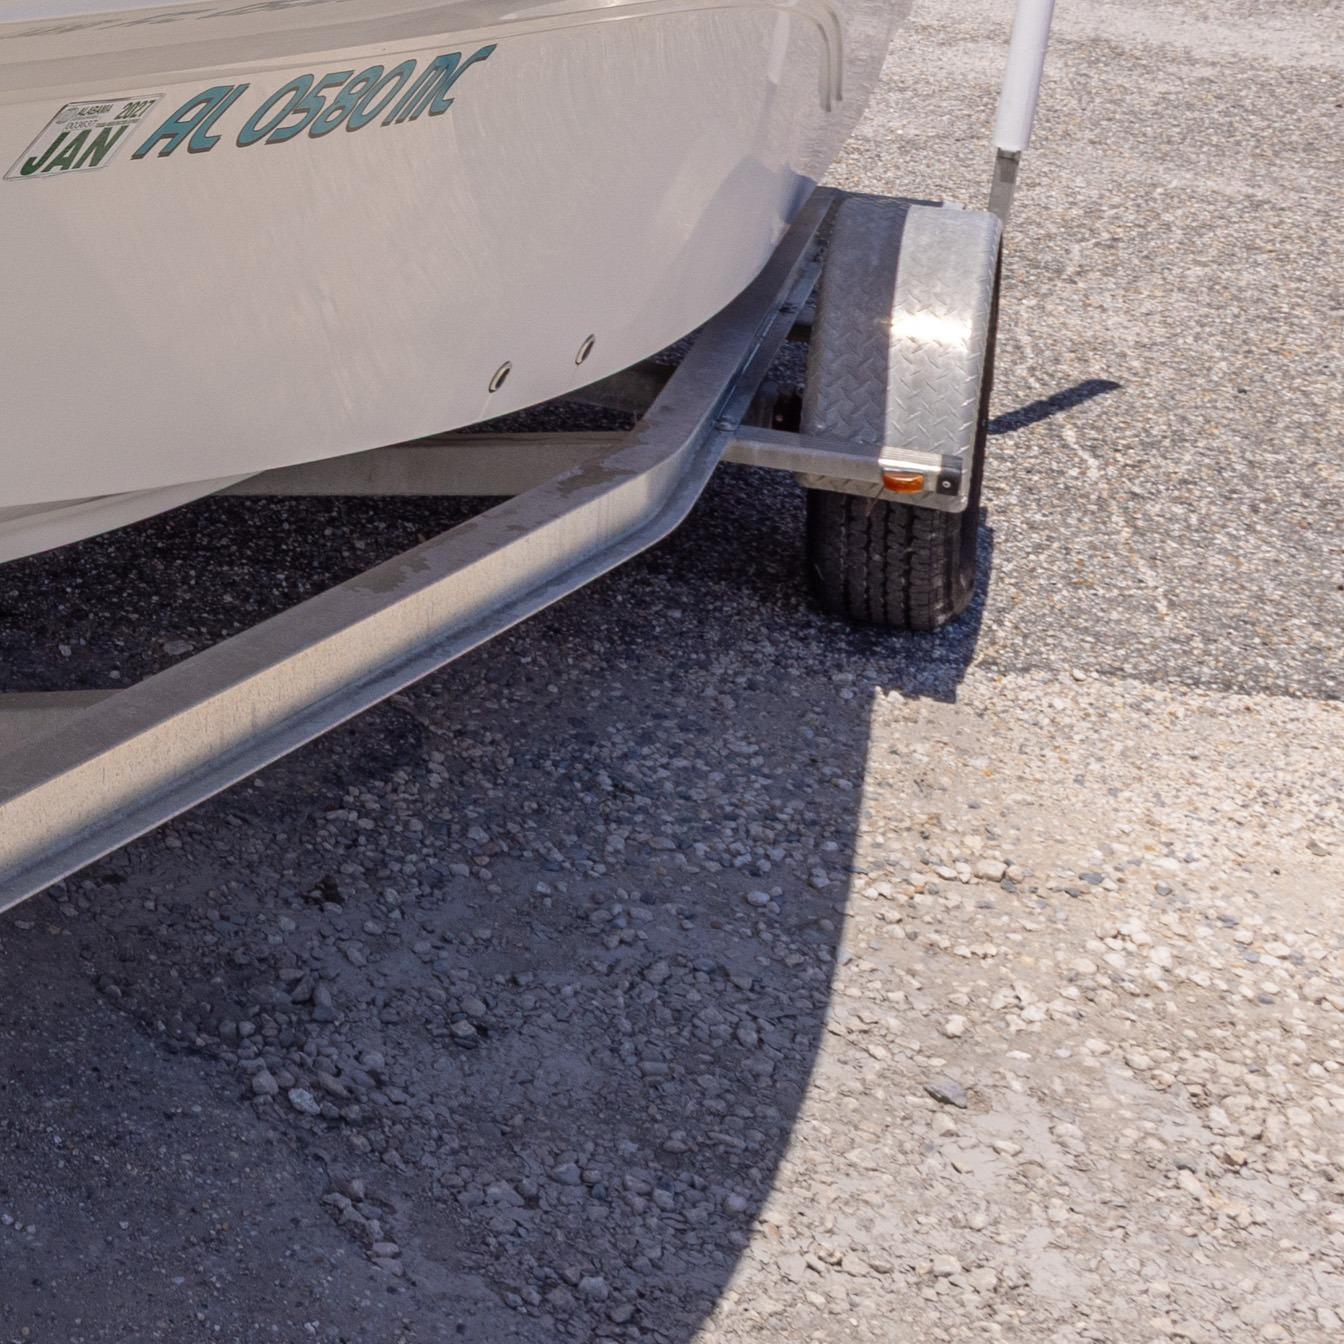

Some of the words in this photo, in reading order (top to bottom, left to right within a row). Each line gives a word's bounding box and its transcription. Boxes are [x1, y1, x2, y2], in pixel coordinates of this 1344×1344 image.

[130, 83, 251, 160] AL
[236, 59, 418, 148] 0580
[20, 124, 130, 176] JAN
